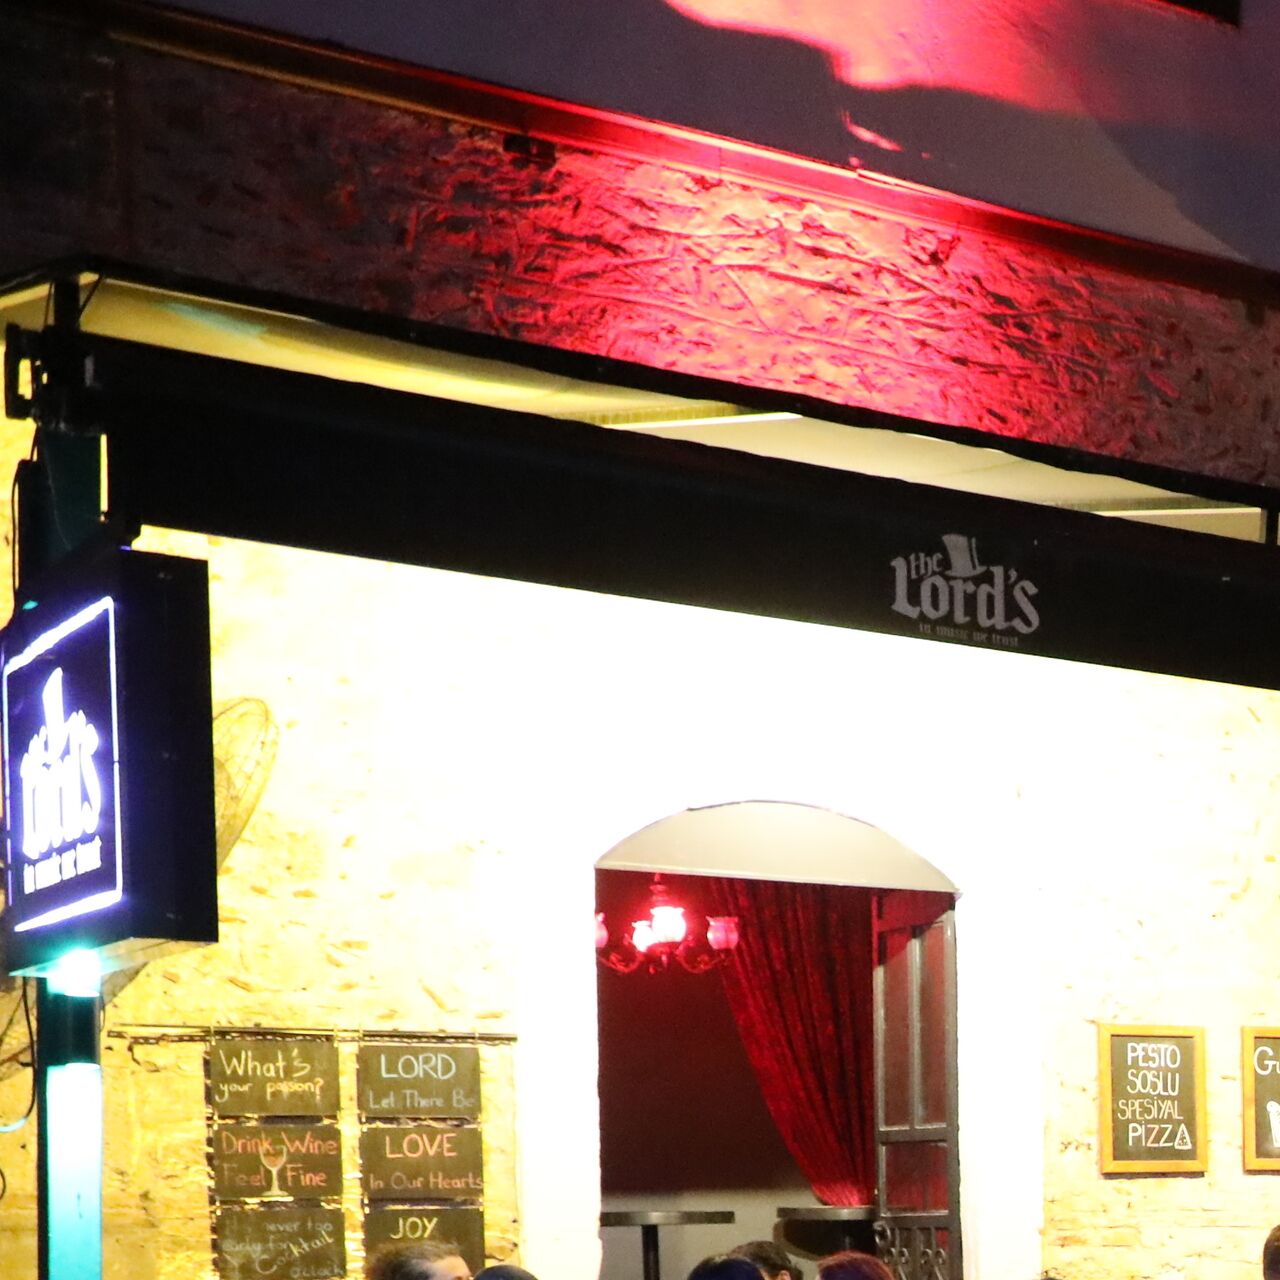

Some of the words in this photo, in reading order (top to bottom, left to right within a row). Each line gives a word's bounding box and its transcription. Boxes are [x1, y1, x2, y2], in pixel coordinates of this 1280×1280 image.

[908, 552, 944, 580] the
[890, 556, 1040, 634] Lord's
[218, 1047, 312, 1079] What's
[380, 1053, 457, 1080] LORD
[1127, 1042, 1180, 1068] PESTO
[214, 1081, 254, 1104] your
[1127, 1069, 1179, 1096] SOSLU
[402, 1088, 445, 1109] There
[220, 1130, 275, 1155] Drink
[281, 1130, 338, 1155] Wine
[385, 1132, 460, 1159] LOVE
[221, 1163, 267, 1187] Feel
[286, 1163, 328, 1187] Fine
[390, 1171, 425, 1190] Our
[429, 1170, 483, 1190] Hearts
[389, 1217, 440, 1241] JOY
